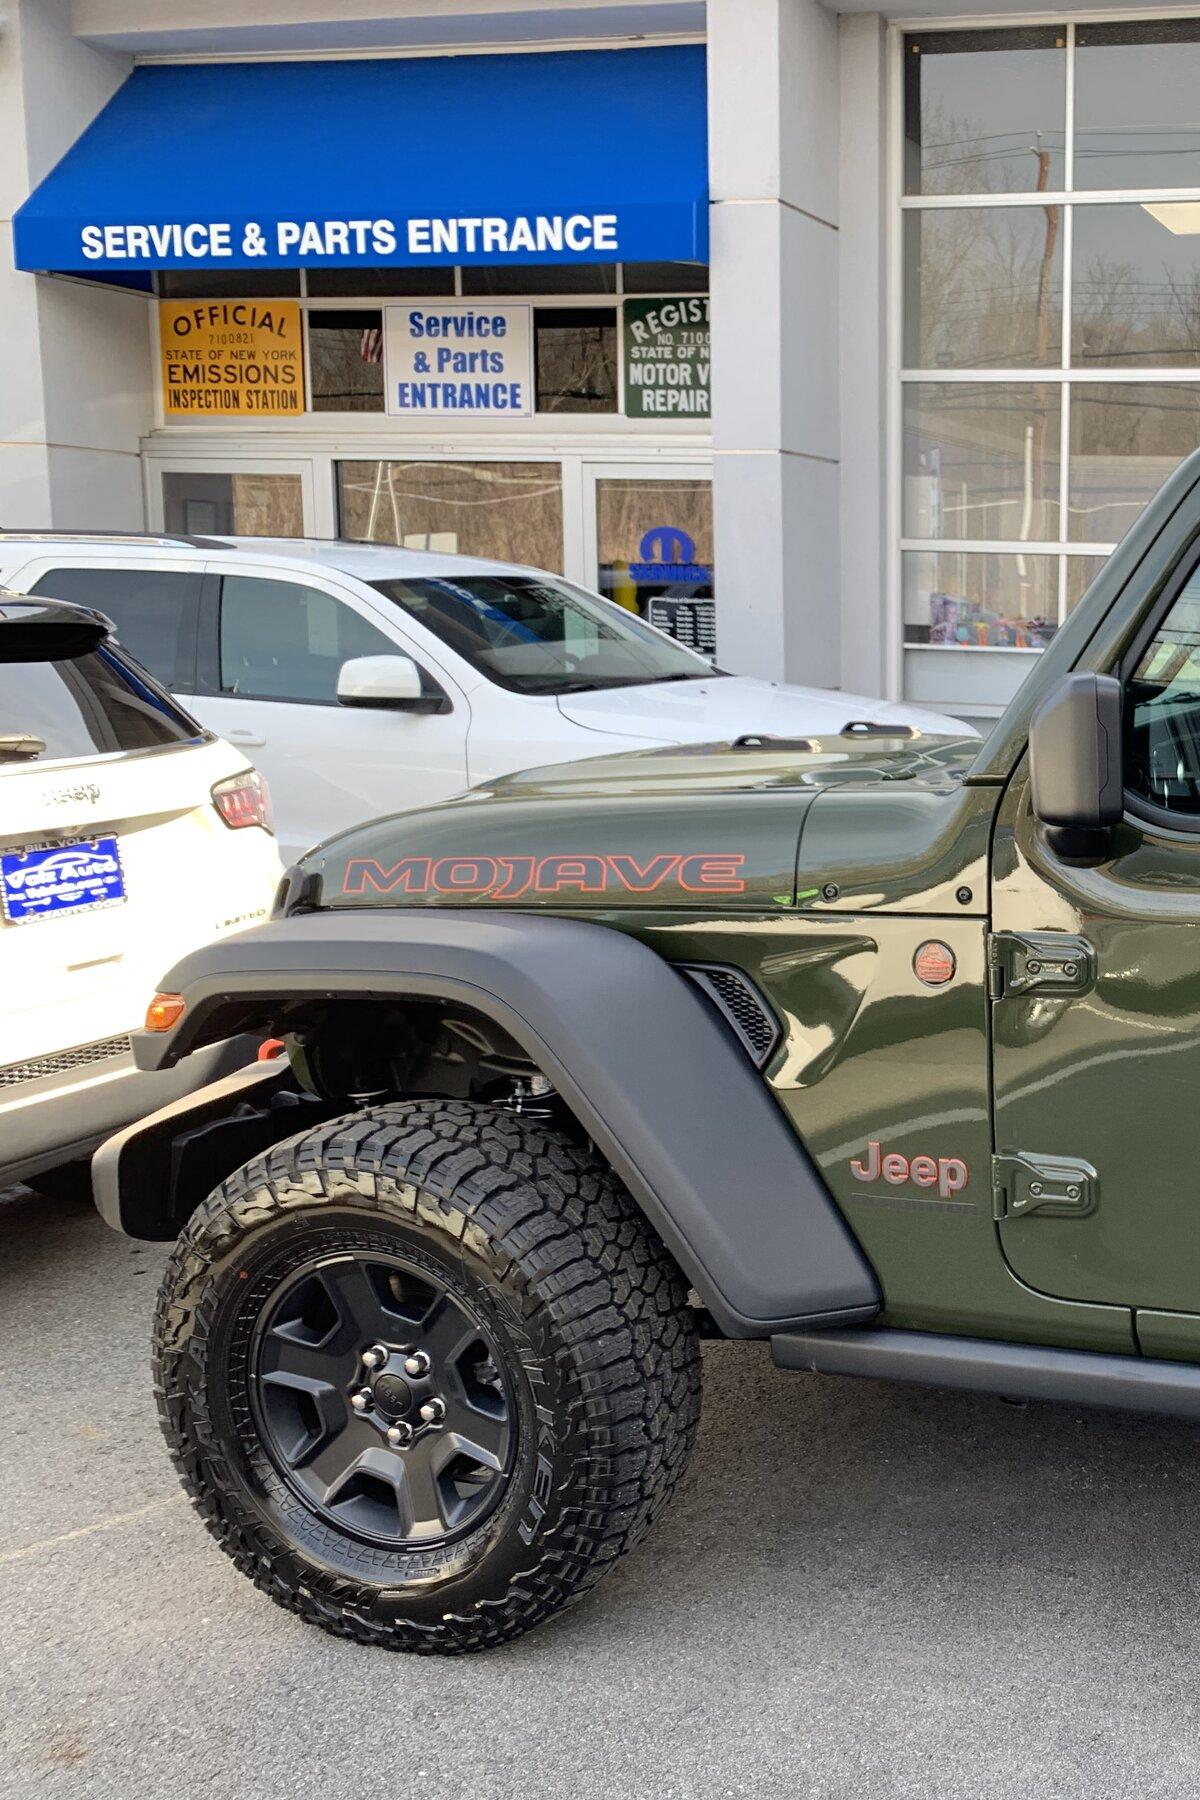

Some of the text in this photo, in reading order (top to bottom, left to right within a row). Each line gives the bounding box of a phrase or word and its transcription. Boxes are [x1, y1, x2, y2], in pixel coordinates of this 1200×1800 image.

[81, 214, 618, 259] SERVICE & PARTS ENTRANCE
[173, 304, 286, 338] OFFICIAL
[408, 310, 507, 338] Service
[208, 332, 254, 345] 7100821
[166, 349, 297, 361] STATE OF NEW YORK
[413, 346, 504, 374] & Parts
[630, 346, 673, 359] STATE
[676, 346, 696, 359] OF
[168, 363, 296, 385] EMISSIONS
[629, 362, 710, 386] MOTOR V
[168, 388, 298, 410] INSPECTION STATION
[398, 382, 522, 409] ENTRANCE
[642, 388, 709, 412] REPAIR
[342, 854, 746, 899] MOJAVE
[850, 1140, 968, 1198] Jeep
